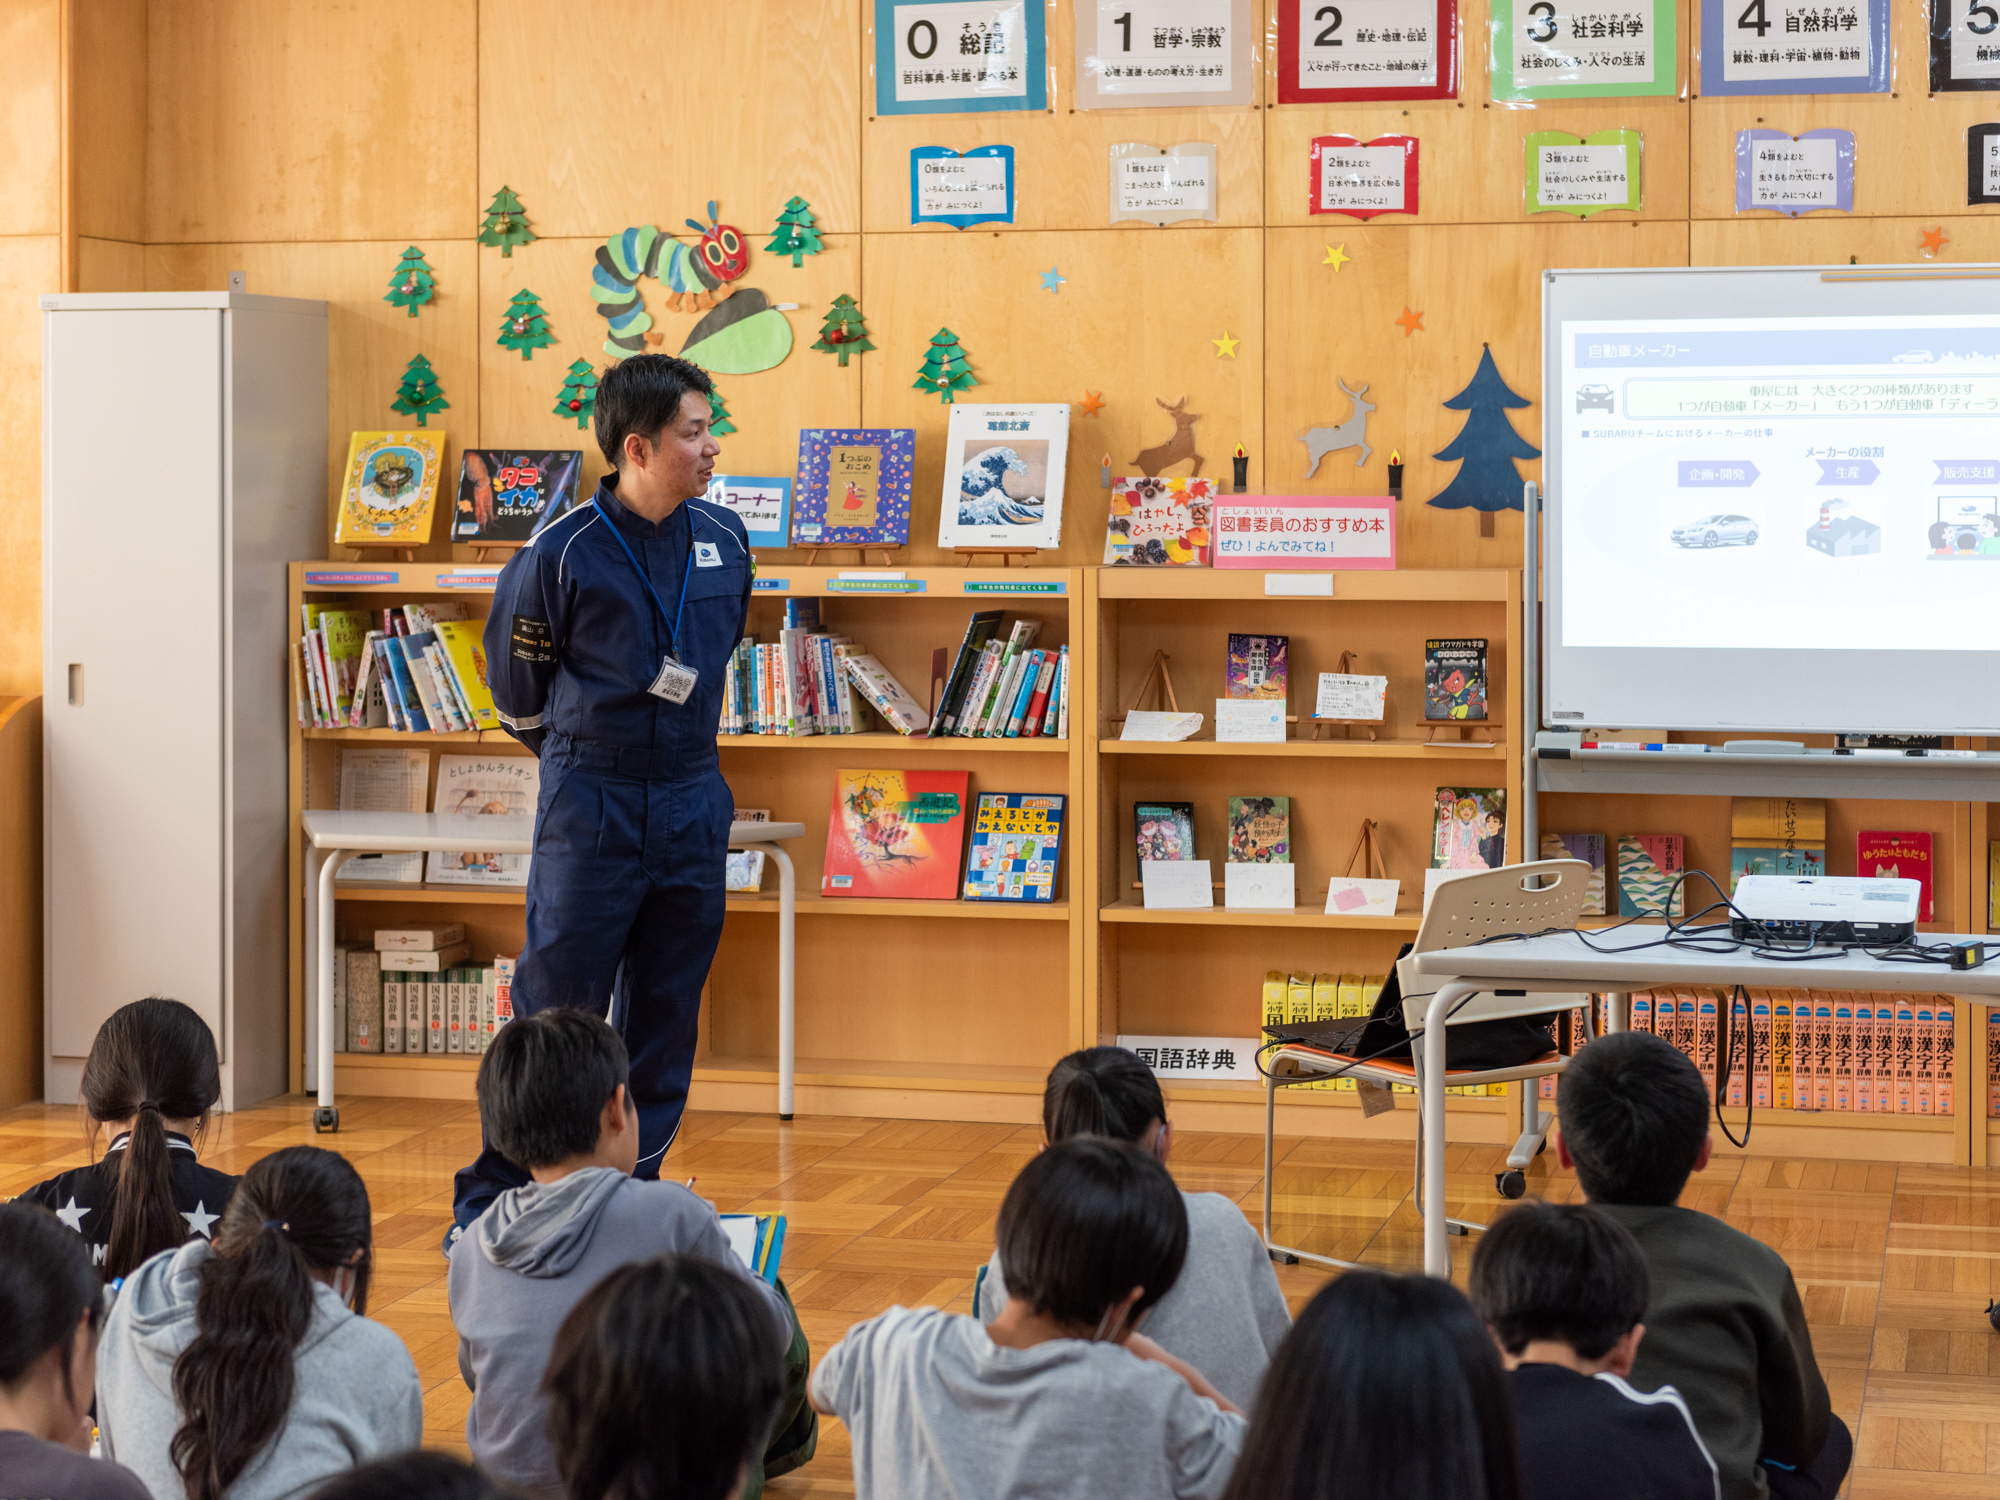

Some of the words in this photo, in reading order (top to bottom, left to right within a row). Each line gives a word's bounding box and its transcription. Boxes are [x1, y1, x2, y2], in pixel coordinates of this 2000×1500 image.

[1527, 1, 1558, 43] 3
[1737, 0, 1772, 37] 4
[1785, 14, 1858, 33] 自然科学
[1966, 0, 1999, 35] 5
[1113, 12, 1132, 52] 1
[1313, 5, 1343, 47] 2
[1571, 20, 1644, 39] 社会科学
[907, 19, 938, 60] 0
[1153, 34, 1222, 49] 哲学・宗教
[1356, 32, 1427, 43] 歴史・地理・伝記
[1521, 55, 1646, 69] 社会のしくみ・人々の生活
[1732, 50, 1860, 65] 算数・理科・宇宙・植物・動物
[1307, 62, 1428, 72] 人々が行ってきたこと・地域の様子
[1328, 157, 1372, 168] 2類をよむと
[1545, 153, 1590, 163] 3類をよむと
[1759, 151, 1804, 161] 4類をよむと
[1328, 179, 1401, 188] 日本や世界を広く知る
[1545, 174, 1626, 183] 社会のしくみや生活する
[1588, 343, 1691, 359] 自動車メーカー
[1749, 385, 1799, 397] 車屋には
[1812, 383, 1975, 397] 大きく2つの種類があります
[1677, 399, 1818, 412] 1つが自動車「メーカー」
[1593, 428, 1774, 438] SUBARUチームにおけるメーカーの仕事
[1805, 446, 1885, 458] メーカーの役割
[1688, 467, 1745, 481] 企画・開発
[1835, 466, 1861, 479] 生産
[1943, 466, 1996, 479] 販売支援
[715, 492, 781, 507] コーナー
[368, 503, 409, 517] てぶくろ
[1132, 522, 1185, 537] ひろったよ
[1220, 517, 1385, 534] 図書委員のおすすめ本
[804, 637, 814, 683] バッテリー
[449, 762, 533, 781] としょかんライオン
[979, 809, 1046, 820] みえるとか
[977, 821, 1057, 833] みえないとか
[1665, 837, 1675, 870] 日本の昔話
[1862, 847, 1928, 861] ゆうたはともだち
[1700, 1029, 1715, 1062] 漢字
[1753, 1031, 1770, 1063] 漢字
[1774, 1031, 1791, 1064] 漢字
[1795, 1033, 1811, 1065] 漢字
[1815, 1033, 1831, 1066] 漢字
[1835, 1034, 1852, 1067] 漢字
[1855, 1035, 1872, 1067] 漢字
[1875, 1035, 1893, 1068] 漢字
[1896, 1036, 1913, 1069] 漢字
[1916, 1036, 1933, 1070] 漢字
[1936, 1037, 1953, 1070] 漢字
[1136, 1047, 1237, 1070] 国語辞典
